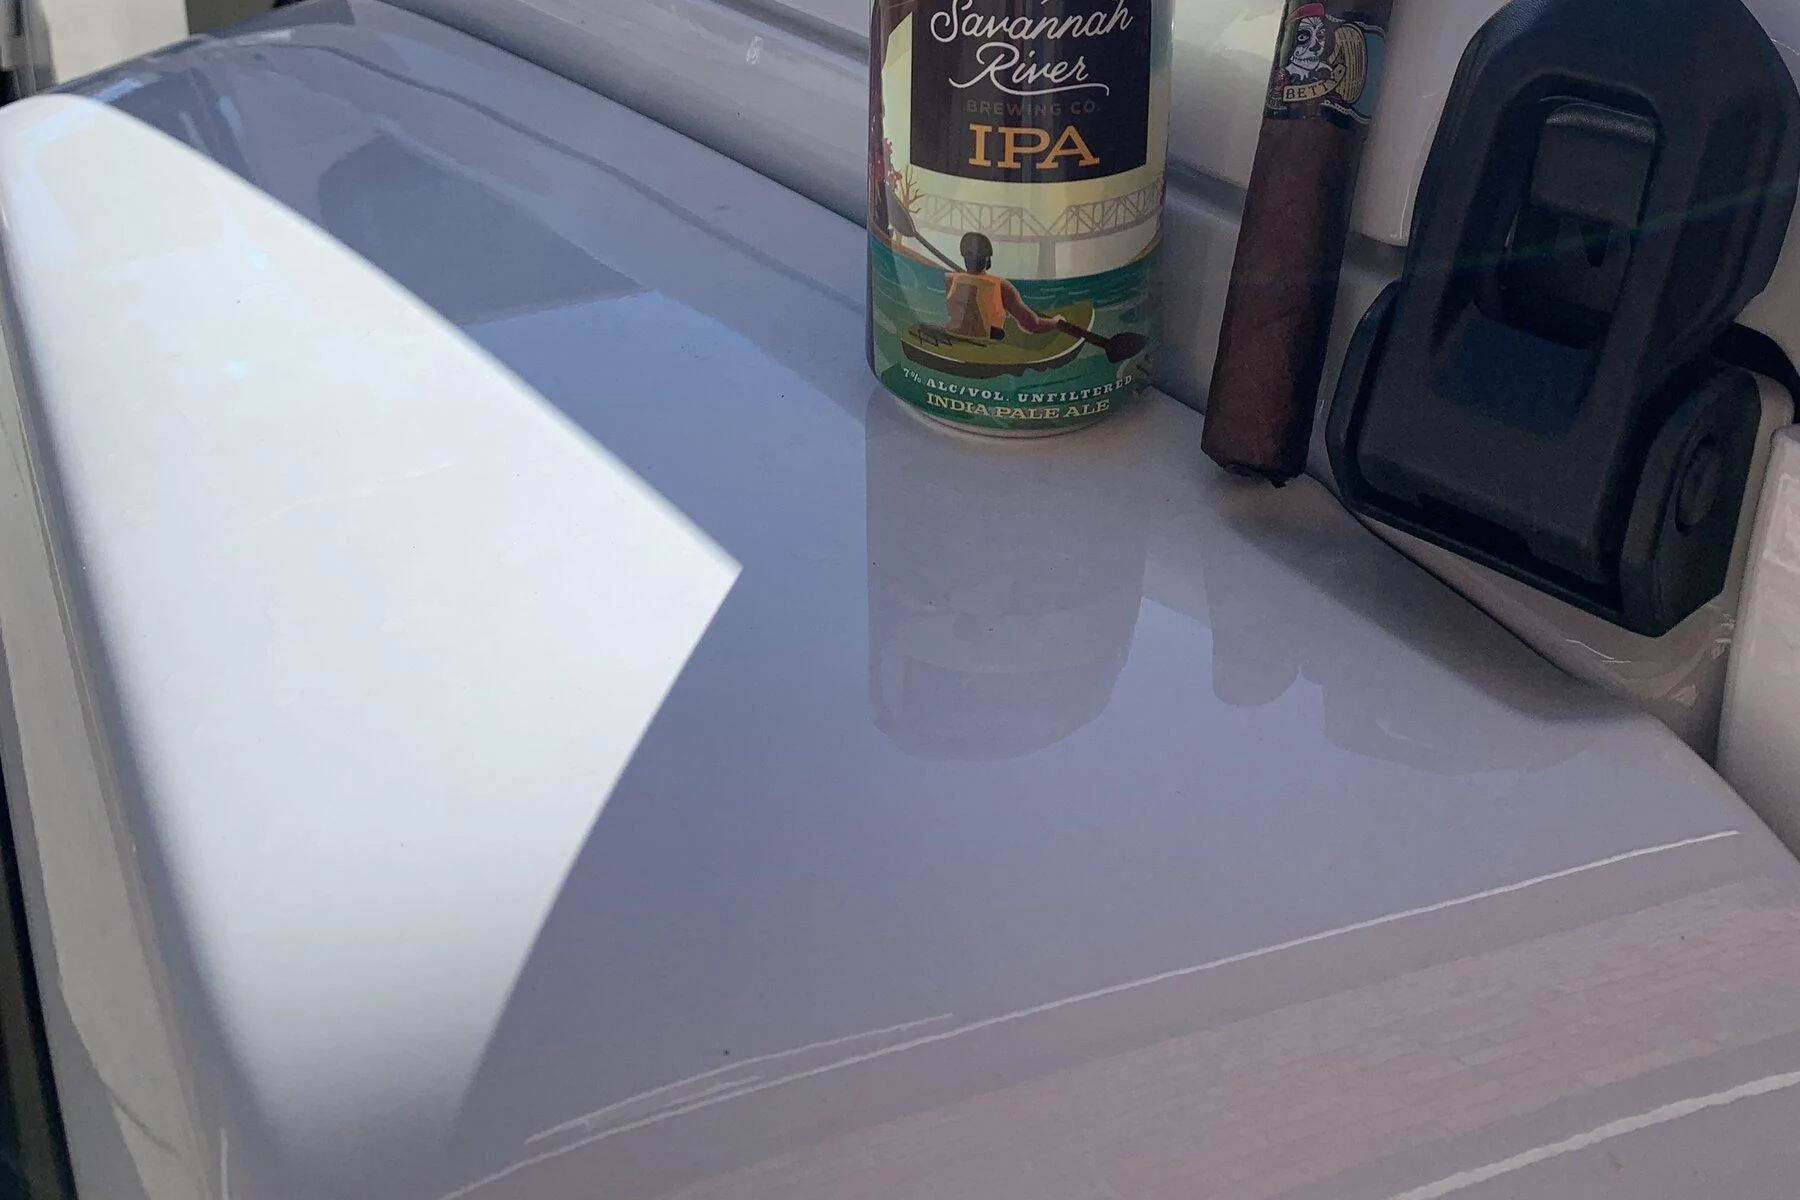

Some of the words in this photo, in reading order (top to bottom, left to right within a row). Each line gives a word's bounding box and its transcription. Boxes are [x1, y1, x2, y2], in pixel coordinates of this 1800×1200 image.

[949, 42, 1110, 97] River
[966, 99, 1062, 117] BREWING
[968, 123, 1100, 171] IPA
[903, 367, 922, 383] 7%
[1017, 374, 1132, 402] UNFILTERED
[926, 392, 990, 417] INDIA
[995, 406, 1060, 419] PALE
[1063, 399, 1110, 418] ALE
